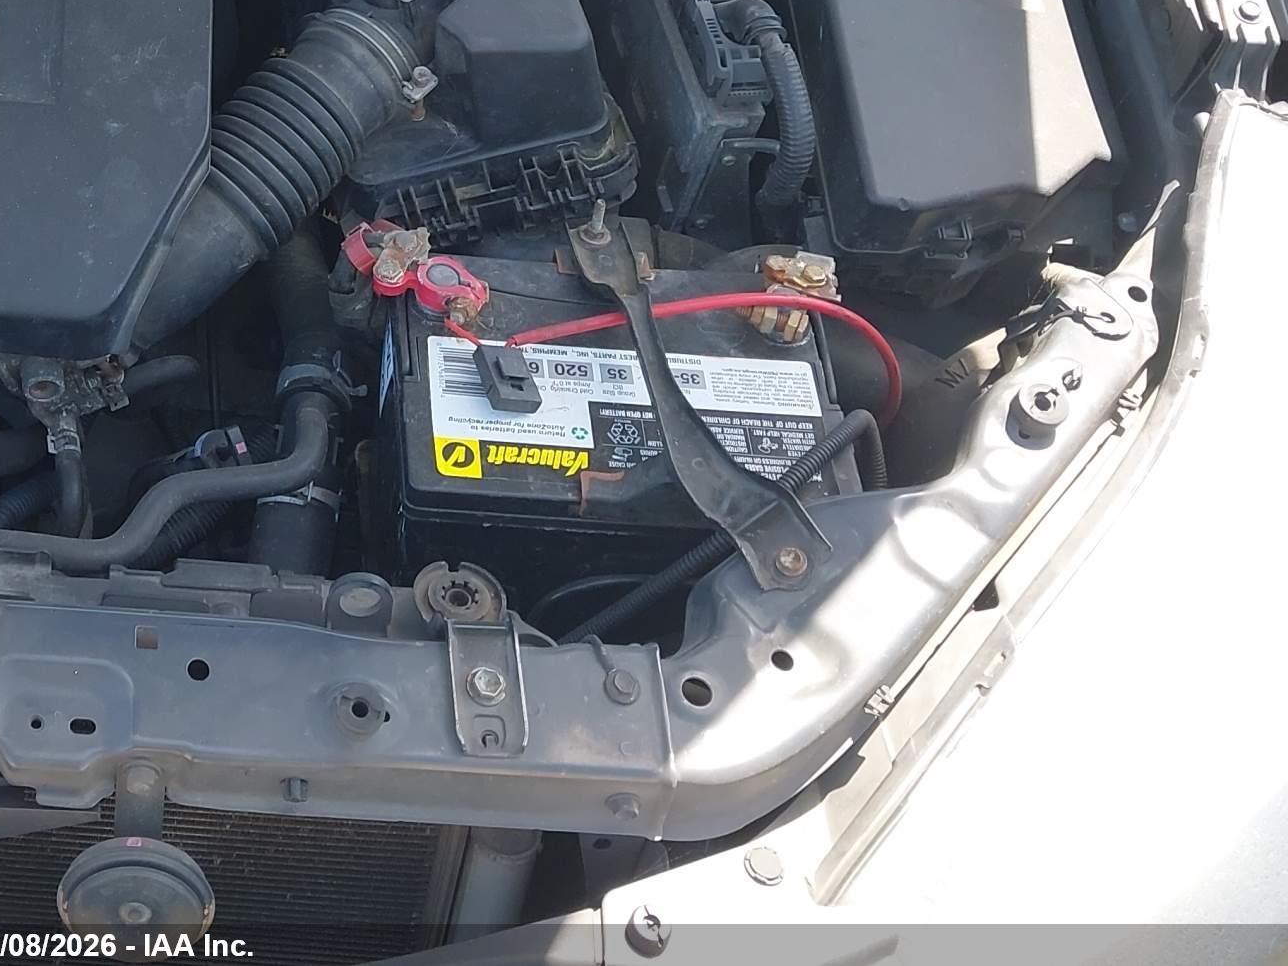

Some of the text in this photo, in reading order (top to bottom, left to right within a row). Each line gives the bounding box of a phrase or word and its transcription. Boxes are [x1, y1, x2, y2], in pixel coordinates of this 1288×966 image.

[554, 363, 588, 377] 520
[607, 368, 628, 380] 35
[626, 410, 641, 418] OPEN
[448, 416, 484, 425] recycling
[485, 419, 512, 427] proper
[480, 426, 515, 434] batteries
[526, 422, 565, 431] AutoZone
[538, 429, 565, 438] Return
[487, 445, 588, 477] Valucraft
